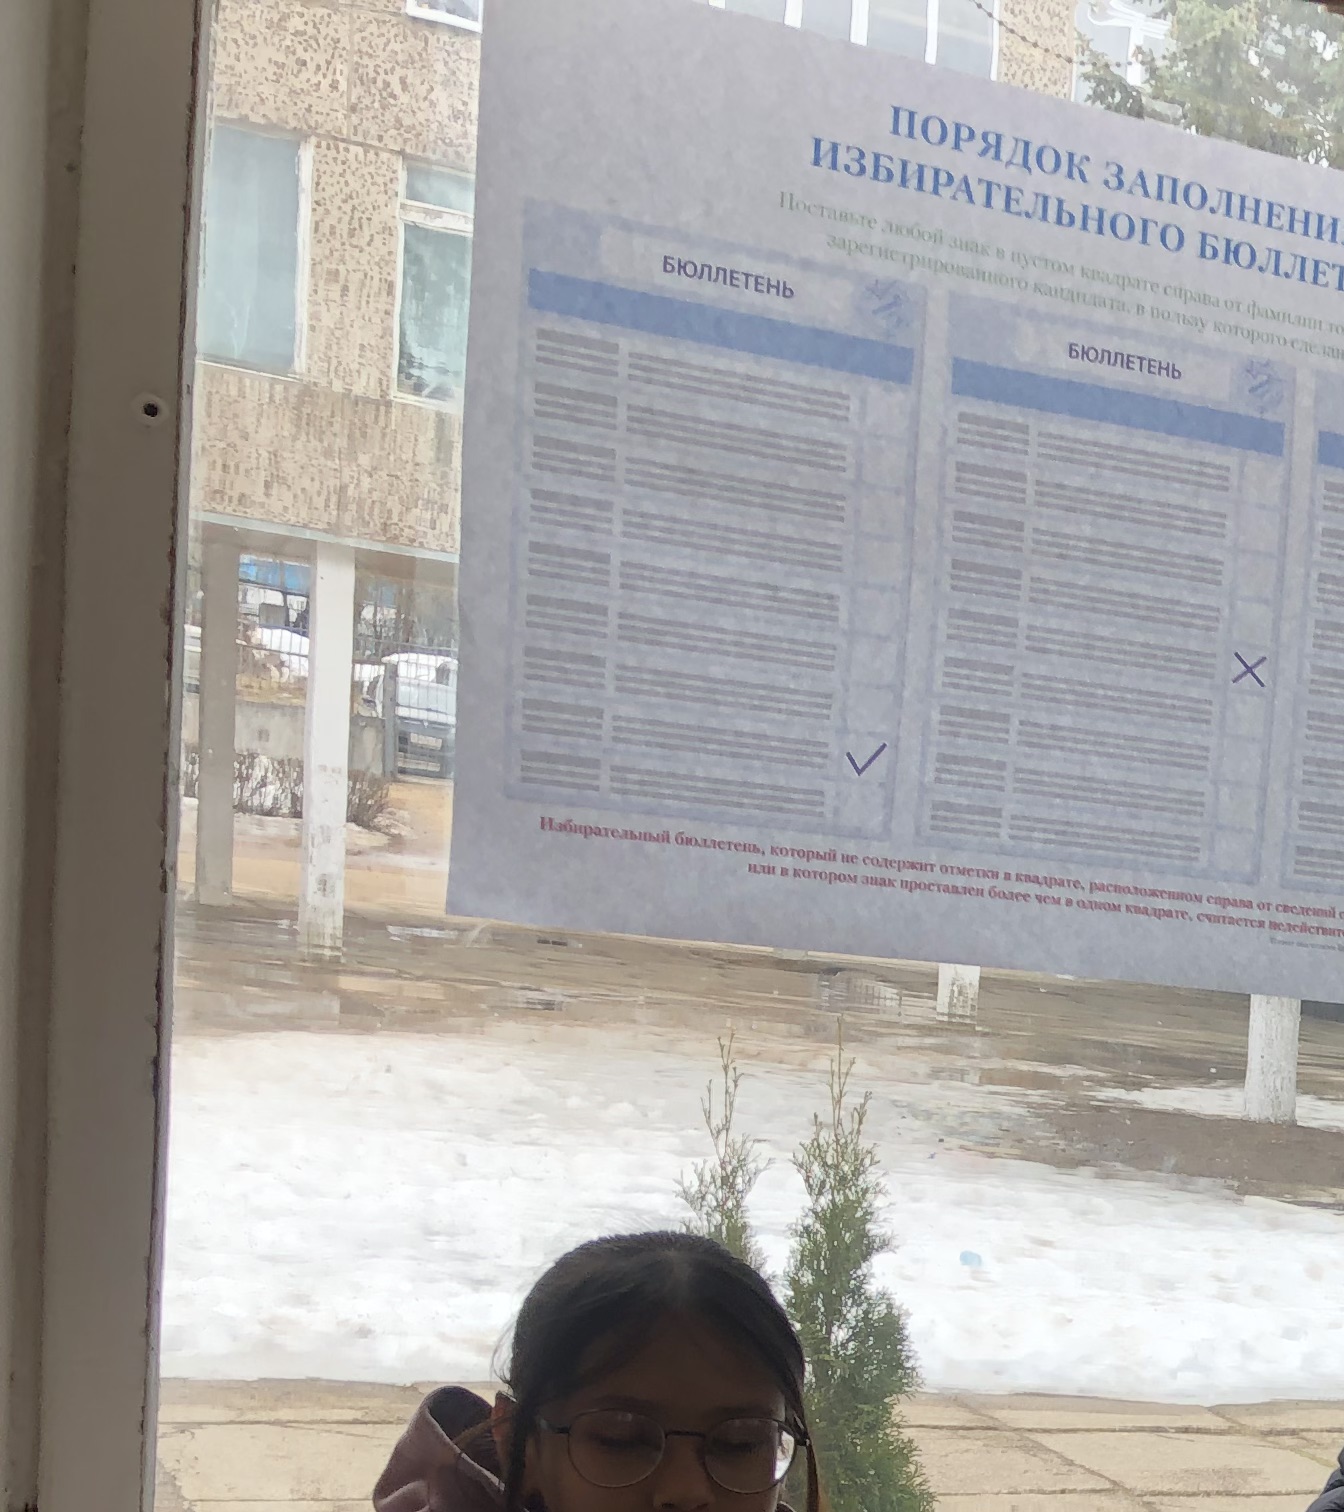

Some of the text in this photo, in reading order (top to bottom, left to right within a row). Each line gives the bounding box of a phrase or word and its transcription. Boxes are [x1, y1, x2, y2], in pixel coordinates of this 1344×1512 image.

[888, 104, 1091, 190] ПОРЯДОК
[809, 132, 1185, 256] ИЗБИРАТЕЛЬНОГО
[660, 249, 796, 305] БЮЛЛЕТЕНЬ
[778, 189, 877, 231] Поставьте
[880, 214, 944, 247] любой
[947, 235, 991, 258] знак
[1009, 248, 1074, 281] пустом
[1079, 263, 1160, 300] квадрате
[1162, 282, 1221, 313] справа
[1223, 297, 1242, 314] от
[1245, 297, 1324, 338] фамилии
[1066, 335, 1183, 385] БЮЛЛЕТЕНЬ
[538, 813, 671, 848] Избирательный
[768, 840, 838, 866] который
[840, 852, 858, 866] не
[861, 853, 935, 878] содержит
[938, 862, 999, 881] отметки
[1088, 878, 1203, 907] расположенном
[1206, 893, 1254, 913] справа
[1256, 898, 1272, 912] от
[1274, 898, 1337, 920] сведений
[747, 860, 776, 876] или
[792, 866, 857, 887] котором
[859, 873, 896, 889] знак
[899, 877, 985, 901] проставлен
[987, 884, 1031, 904] более
[1034, 892, 1061, 907] чем
[1075, 897, 1122, 915] одном
[1196, 910, 1265, 931] считается
